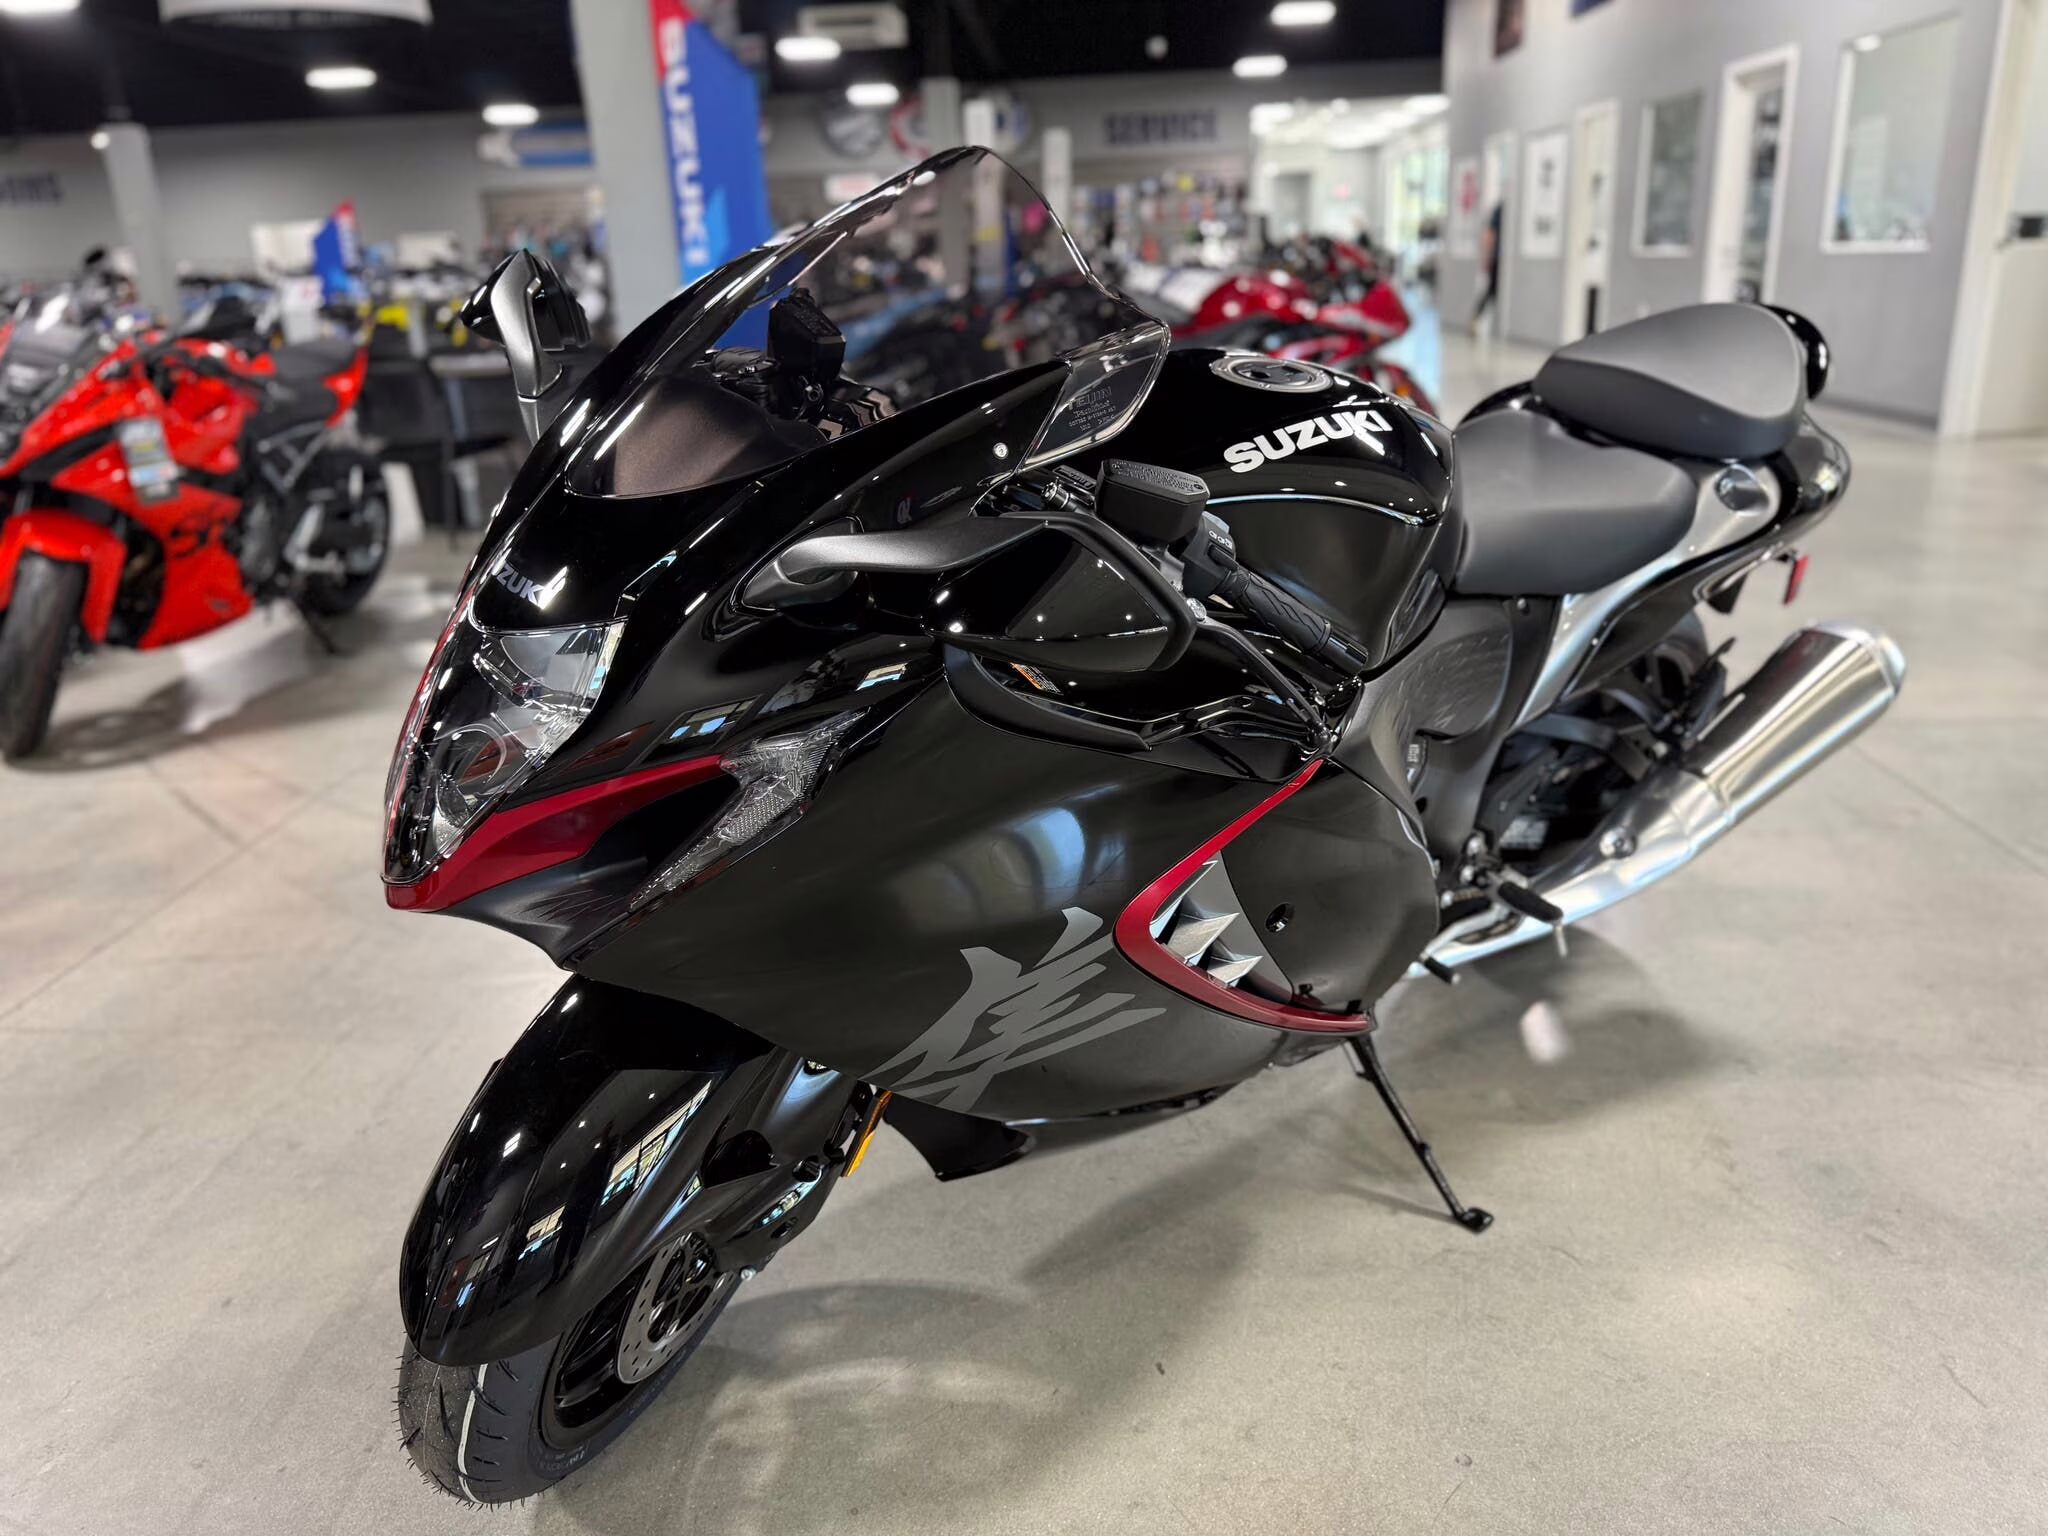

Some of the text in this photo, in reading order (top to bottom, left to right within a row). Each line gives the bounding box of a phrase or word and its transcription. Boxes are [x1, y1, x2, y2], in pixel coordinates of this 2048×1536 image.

[658, 16, 709, 265] SUZUKI
[1223, 410, 1393, 473] SUZUKI
[492, 558, 552, 610] ZUK
